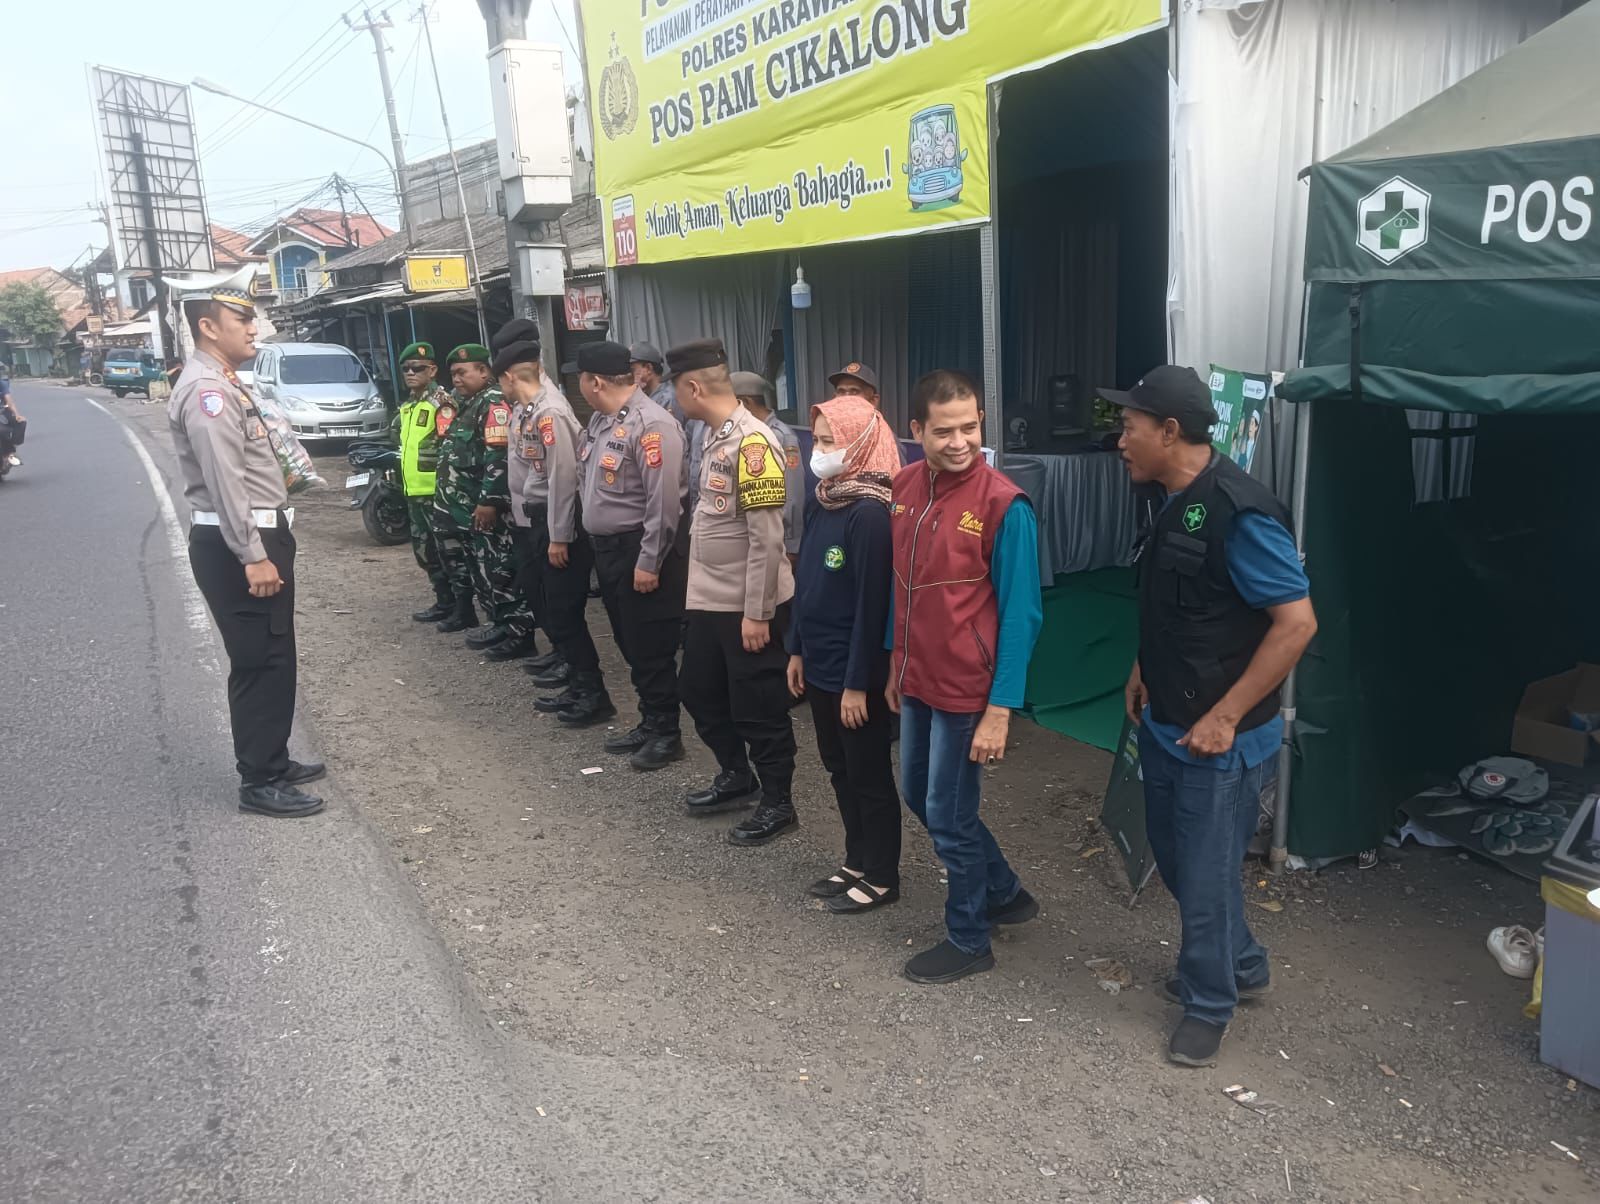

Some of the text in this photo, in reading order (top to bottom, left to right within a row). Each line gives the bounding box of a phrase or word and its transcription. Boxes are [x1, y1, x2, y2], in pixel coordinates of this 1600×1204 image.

[645, 7, 692, 56] PELAYANAN
[681, 22, 748, 78] POLRES
[649, 0, 967, 144] POS PAM CIKALONG
[645, 202, 684, 239] Mudik
[683, 200, 724, 233] Aman,
[725, 184, 792, 223] Keluarga
[1480, 175, 1594, 244] POS
[615, 228, 636, 257] 110
